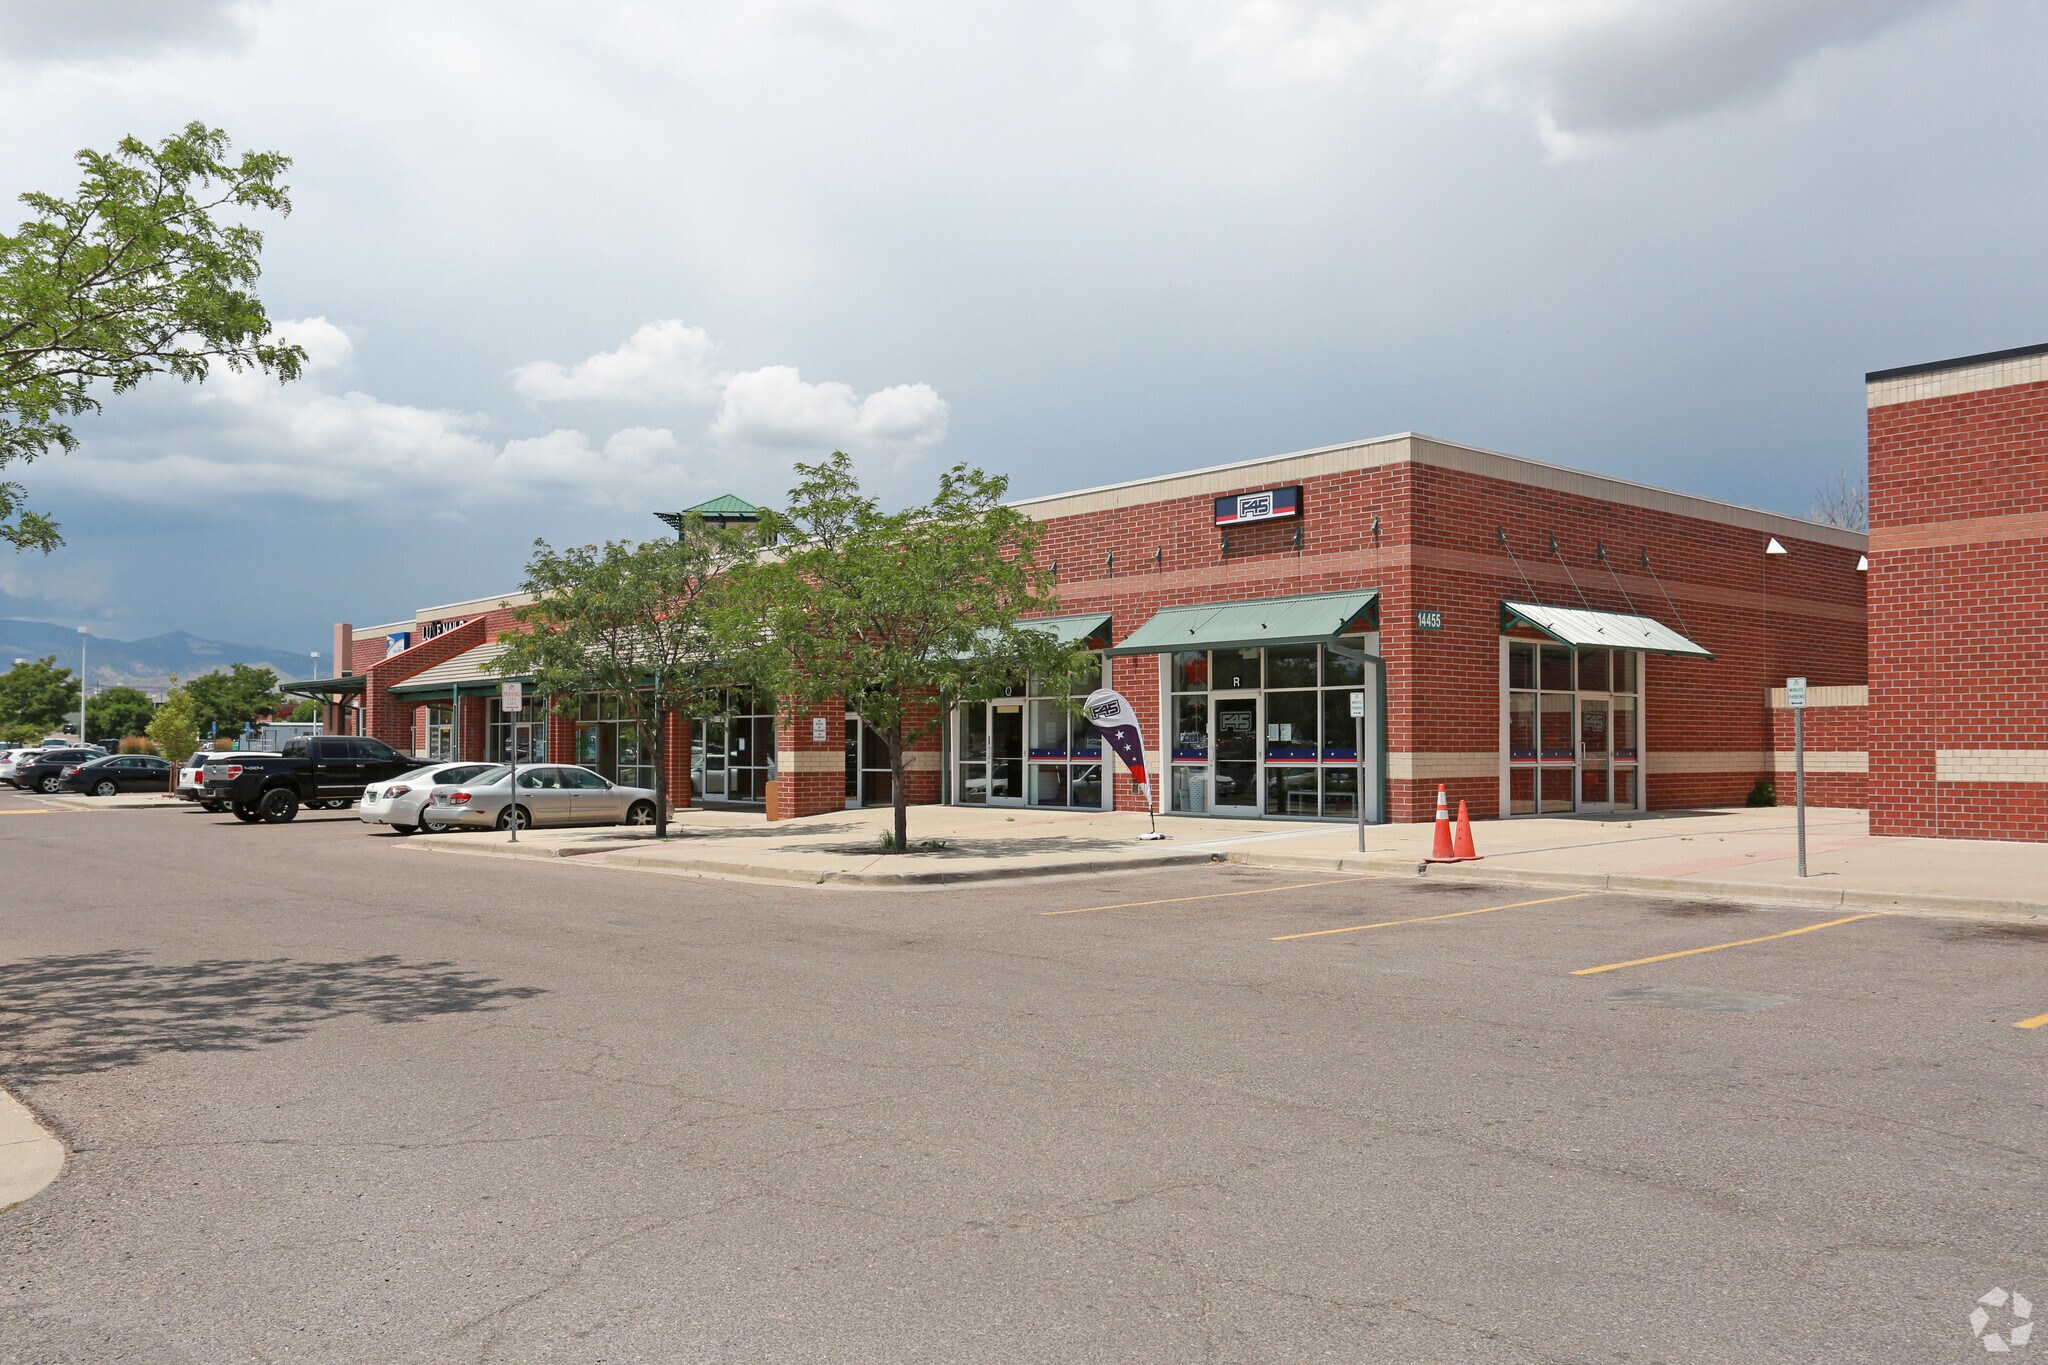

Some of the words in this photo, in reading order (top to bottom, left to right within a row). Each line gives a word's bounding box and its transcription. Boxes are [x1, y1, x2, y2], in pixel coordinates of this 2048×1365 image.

[1240, 495, 1271, 518] F45
[1418, 612, 1440, 627] 14455
[1005, 686, 1012, 697] Q
[1233, 677, 1240, 687] R
[1090, 699, 1120, 720] F45
[1220, 711, 1252, 732] F45
[1583, 711, 1607, 732] F45
